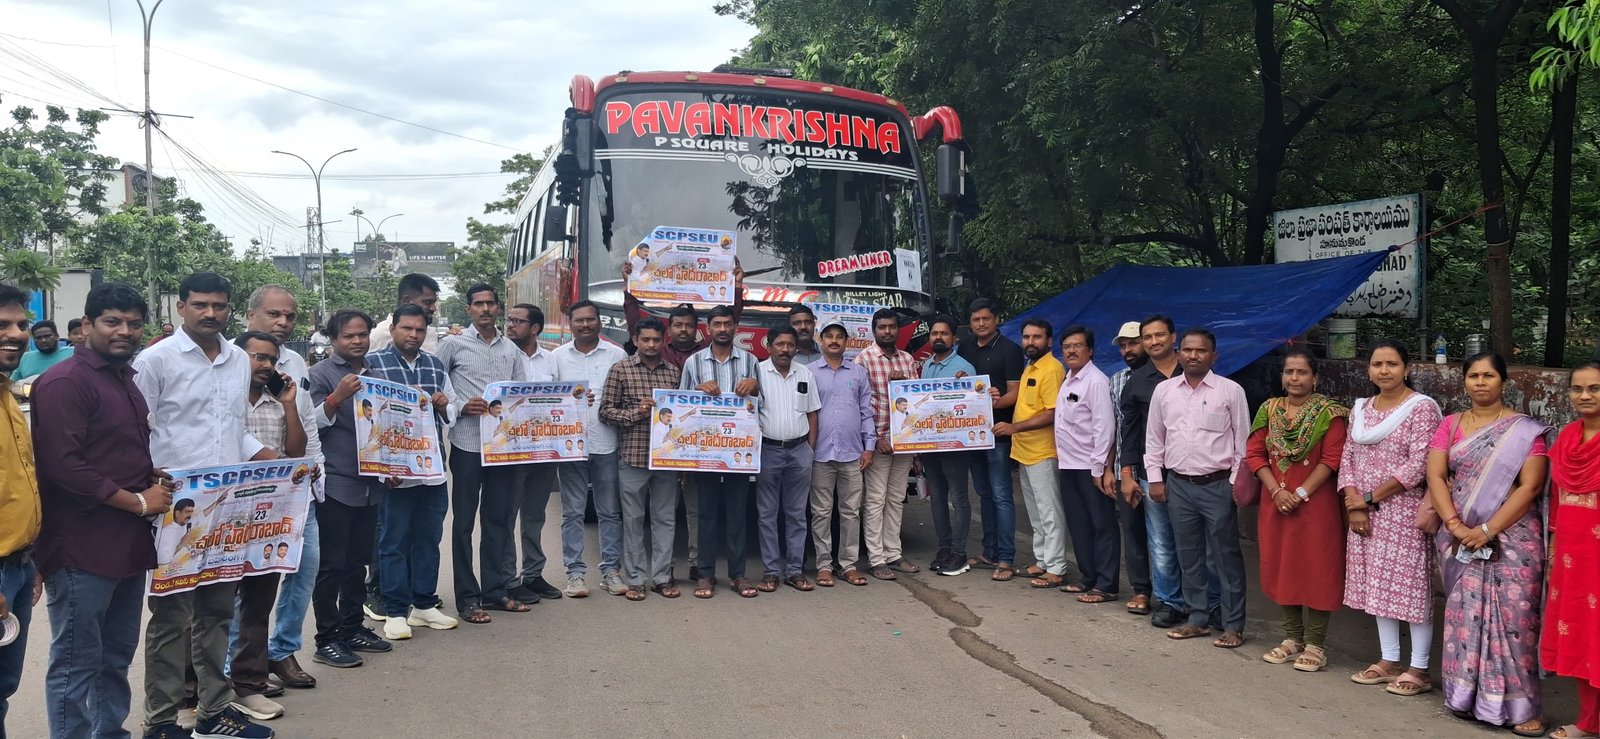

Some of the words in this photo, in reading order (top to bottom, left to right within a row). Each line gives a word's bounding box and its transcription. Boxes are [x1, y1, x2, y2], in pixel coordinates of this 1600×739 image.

[605, 100, 901, 155] PAVANKRISHNA
[654, 136, 668, 147] P
[671, 138, 750, 152] SQUARE
[767, 143, 859, 161] HOLIDAYS
[1298, 216, 1317, 241] ప్రజా
[1318, 210, 1351, 237] పరిషత్
[1352, 204, 1410, 235] కార్యాలయము
[648, 230, 719, 243] SCPSEU
[1319, 235, 1366, 250] హనుమకొండ
[1315, 250, 1341, 258] OFFICE
[818, 255, 859, 277] DREAM
[860, 251, 893, 270] LINER
[872, 293, 903, 307] STAR
[813, 303, 875, 315] TSCPSEU
[366, 382, 418, 403] TSCPSEU
[499, 385, 572, 396] TSCPSEU
[901, 381, 972, 393] TSCPSEU
[667, 394, 745, 407] TSCPSEU
[187, 464, 294, 490] TSCPSEU
[254, 510, 266, 521] 23
